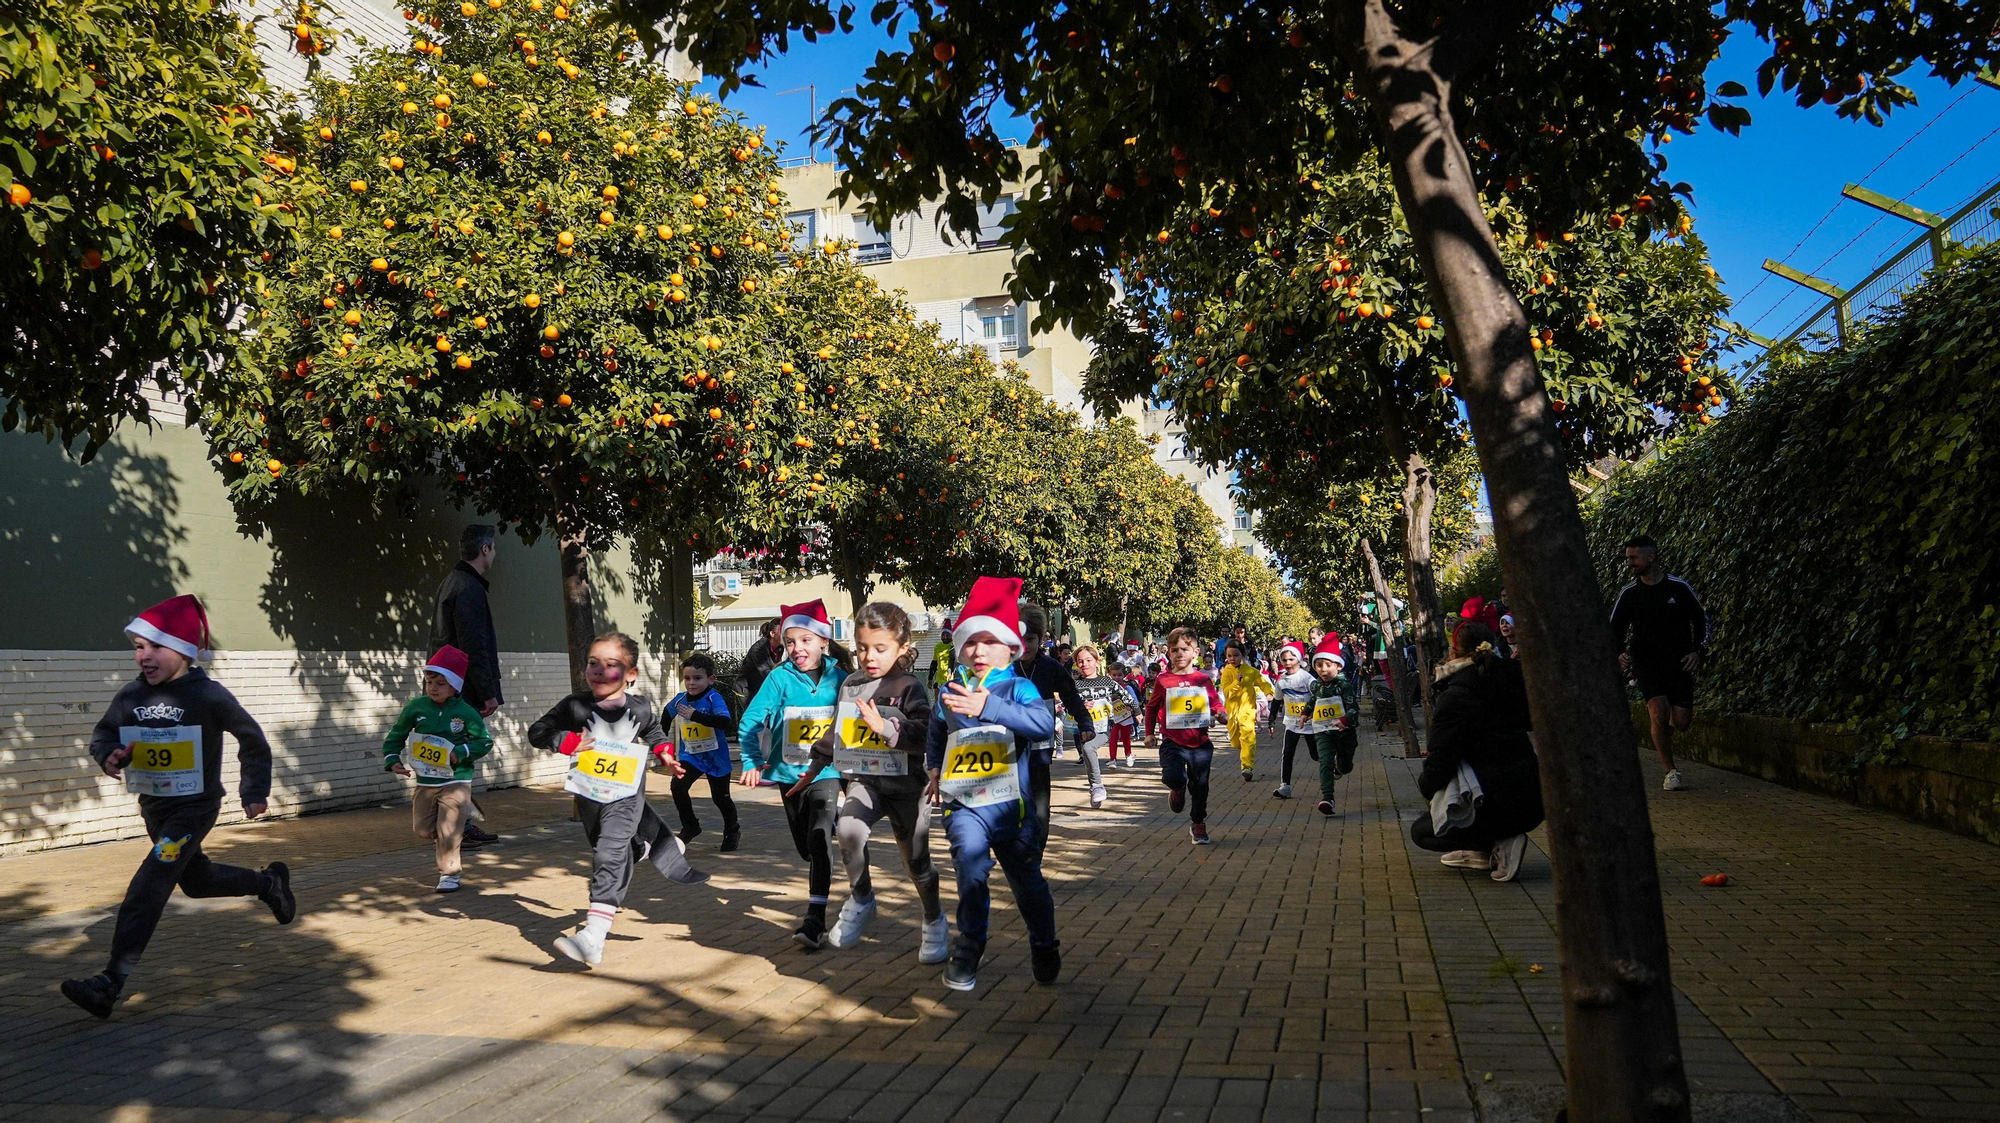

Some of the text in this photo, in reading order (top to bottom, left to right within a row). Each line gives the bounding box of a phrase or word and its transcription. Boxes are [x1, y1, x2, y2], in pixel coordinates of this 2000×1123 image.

[1091, 707, 1109, 720] 115
[1185, 700, 1193, 711] 5
[1317, 707, 1335, 718] 160
[686, 727, 699, 738] 71
[858, 725, 881, 745] 74
[147, 748, 172, 767] 39
[419, 745, 441, 763] 239
[952, 751, 994, 774] 220
[594, 758, 618, 777] 54
